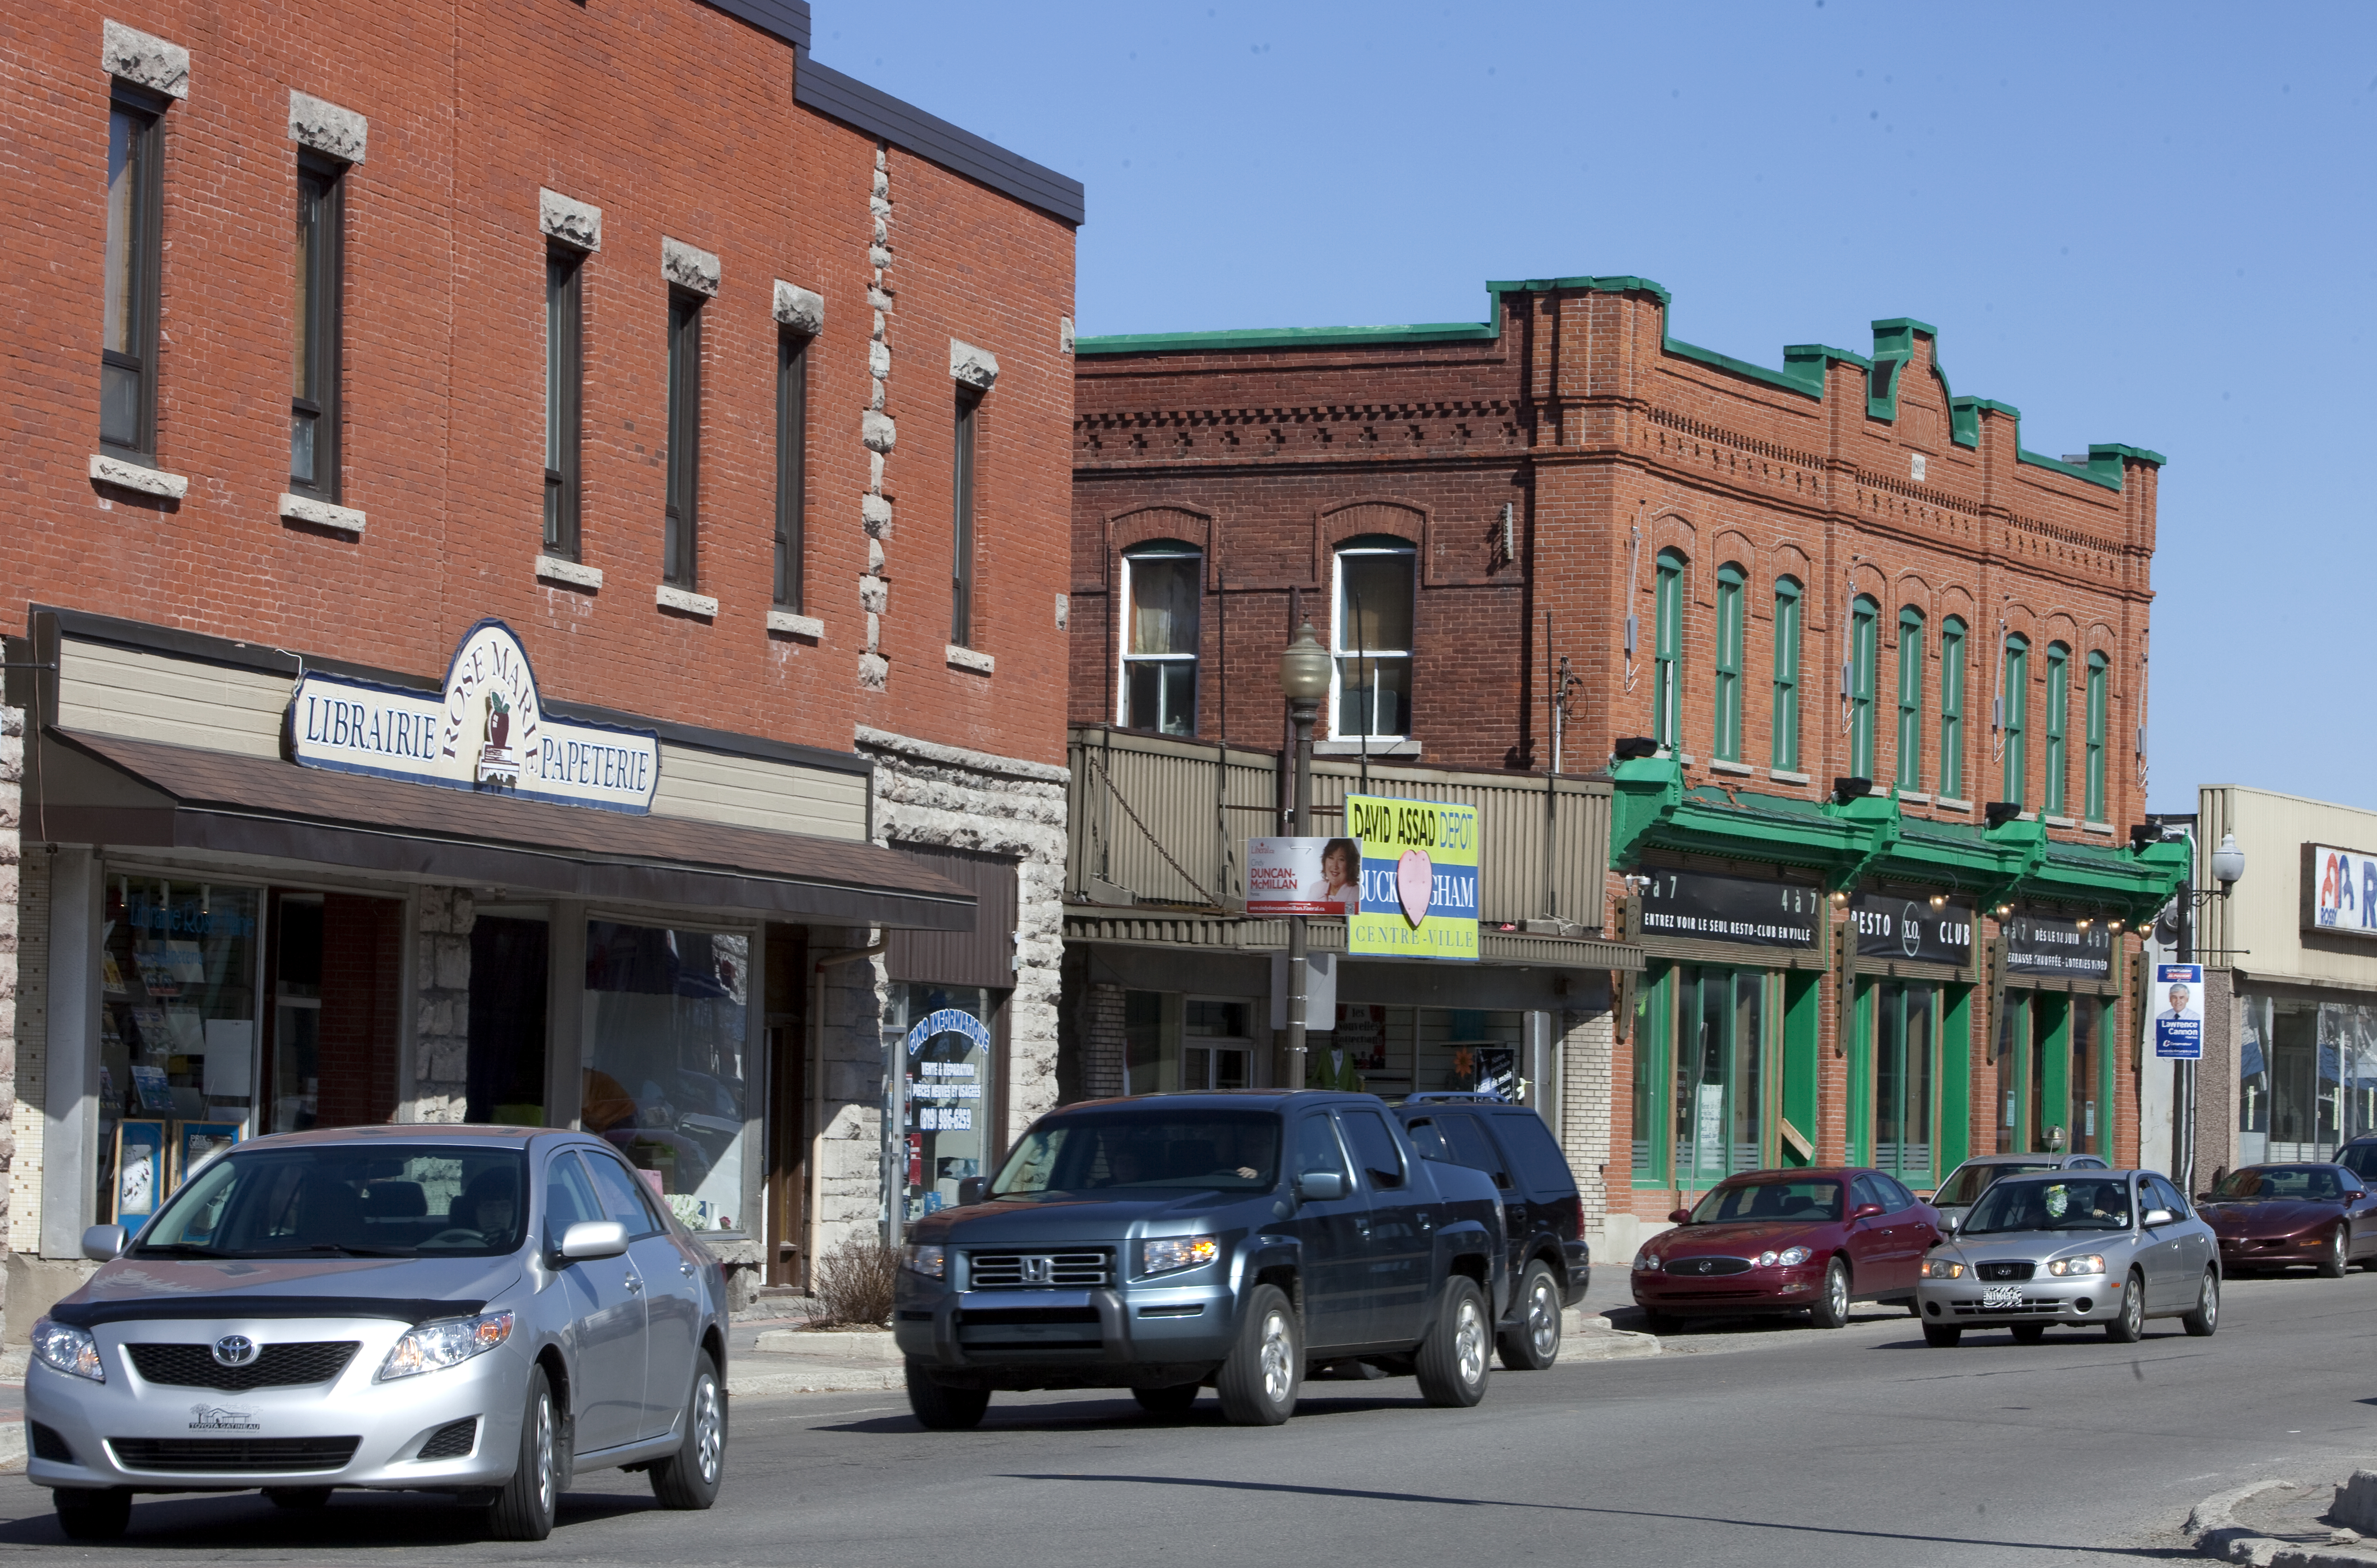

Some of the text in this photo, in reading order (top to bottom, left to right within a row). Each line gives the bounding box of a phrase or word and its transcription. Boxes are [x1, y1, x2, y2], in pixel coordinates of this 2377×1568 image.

[441, 640, 539, 775] ROSE MARIE
[305, 693, 437, 763] LIBRAIRIE
[540, 734, 650, 794] PAPETERIE
[1354, 803, 1473, 850] DAVID ASSAD DÉPÔT
[1250, 879, 1297, 890] McMILLAN
[1251, 868, 1296, 879] DUNCAN-
[1359, 870, 1475, 908] BUCKGHAM
[1670, 876, 1677, 899] 7
[1781, 889, 1817, 915] 4 à 7
[1356, 925, 1473, 948] CENTRE-VILLE
[1645, 912, 1810, 941] ENTREZ VOIR LE SEUL RESTO-CLUB EN VILLE
[1904, 920, 1920, 939] X.O.
[1939, 921, 1970, 946] CLUB
[2021, 924, 2026, 940] 7
[2035, 927, 2047, 941] DÈS
[2047, 930, 2056, 942] LE
[2087, 930, 2109, 948] 4 à 7
[2008, 952, 2032, 964] ERRASSE
[908, 1008, 991, 1055] GINO INFORMATIQUE
[921, 1062, 938, 1076] VENTE
[931, 1084, 951, 1099] NEUVES
[951, 1084, 958, 1098] ET
[920, 1107, 972, 1131] (819) 986-6259
[1986, 1292, 2019, 1301] NIKITA
